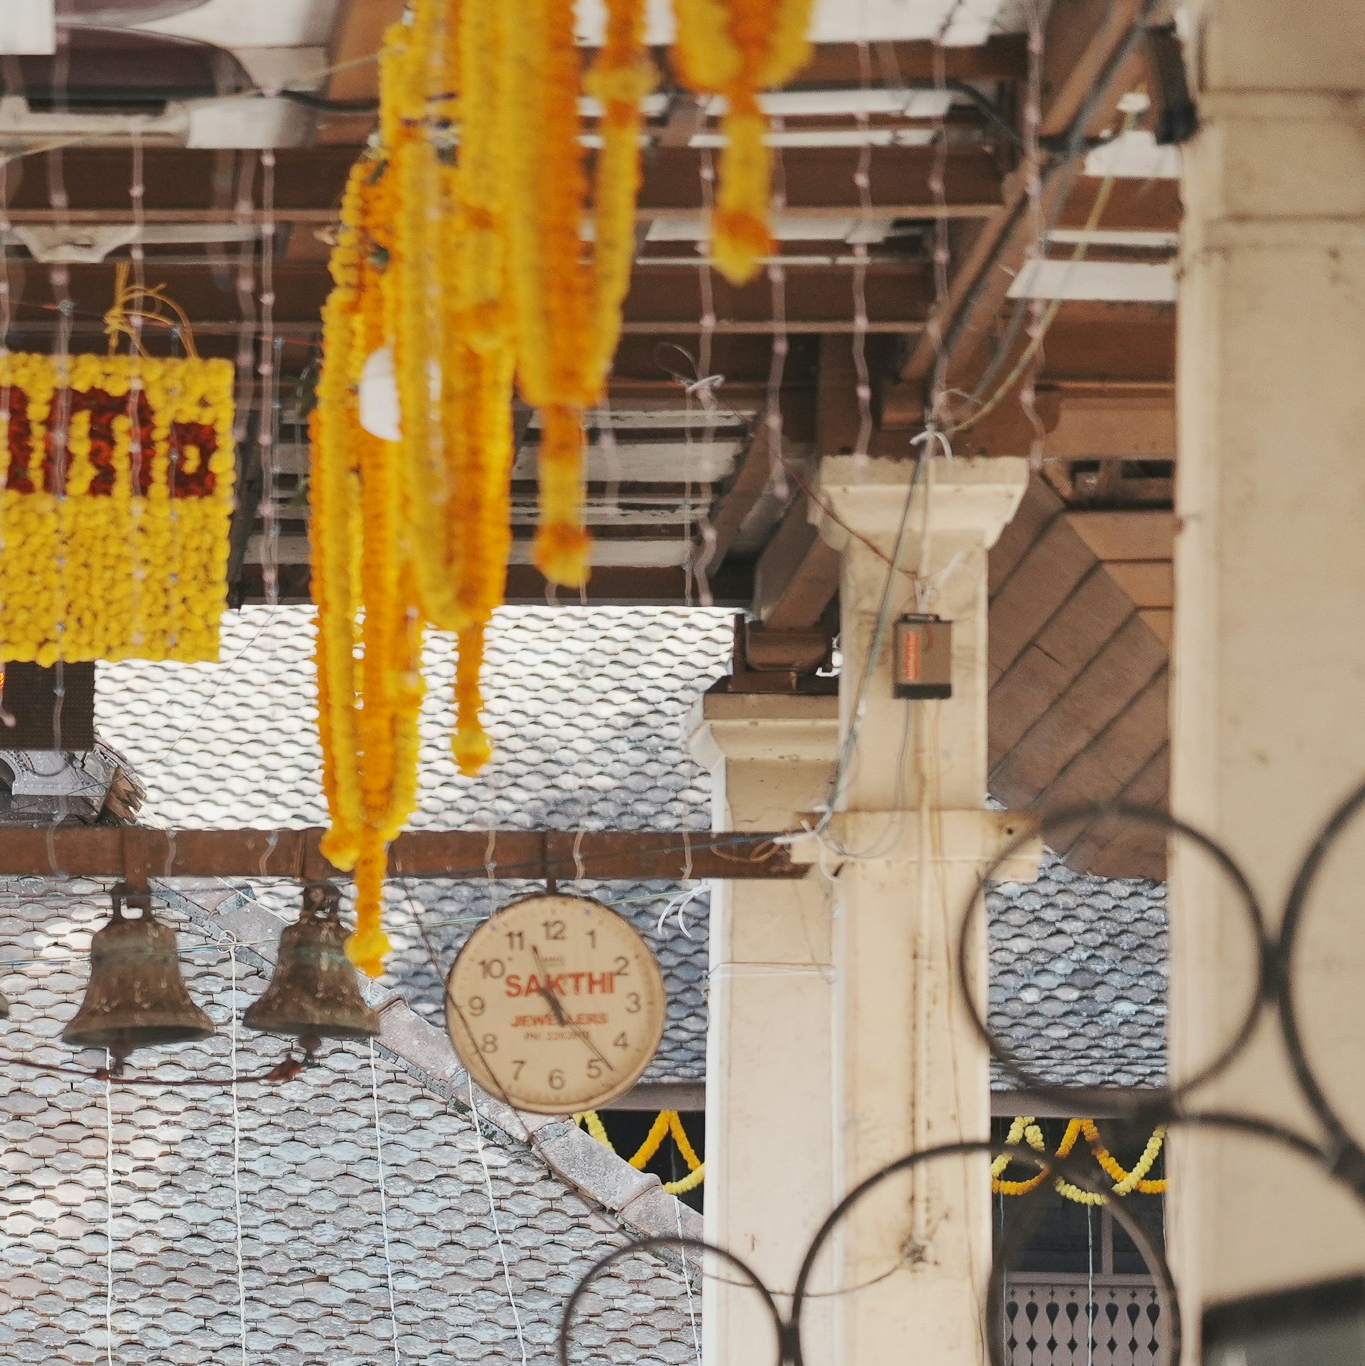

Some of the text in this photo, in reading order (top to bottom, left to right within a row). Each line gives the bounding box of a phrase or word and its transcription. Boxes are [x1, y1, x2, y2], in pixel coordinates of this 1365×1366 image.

[506, 931, 525, 950] 11
[542, 920, 566, 941] 12
[586, 929, 597, 949] 1
[478, 959, 506, 979] 10
[614, 956, 630, 976] 2
[504, 971, 616, 998] SAKTHI
[469, 996, 485, 1017] 9
[625, 992, 641, 1014] 3
[481, 1033, 498, 1054] 8
[613, 1031, 629, 1050] 4
[512, 1060, 526, 1081] 7
[586, 1058, 603, 1079] 5
[548, 1069, 566, 1090] 6
